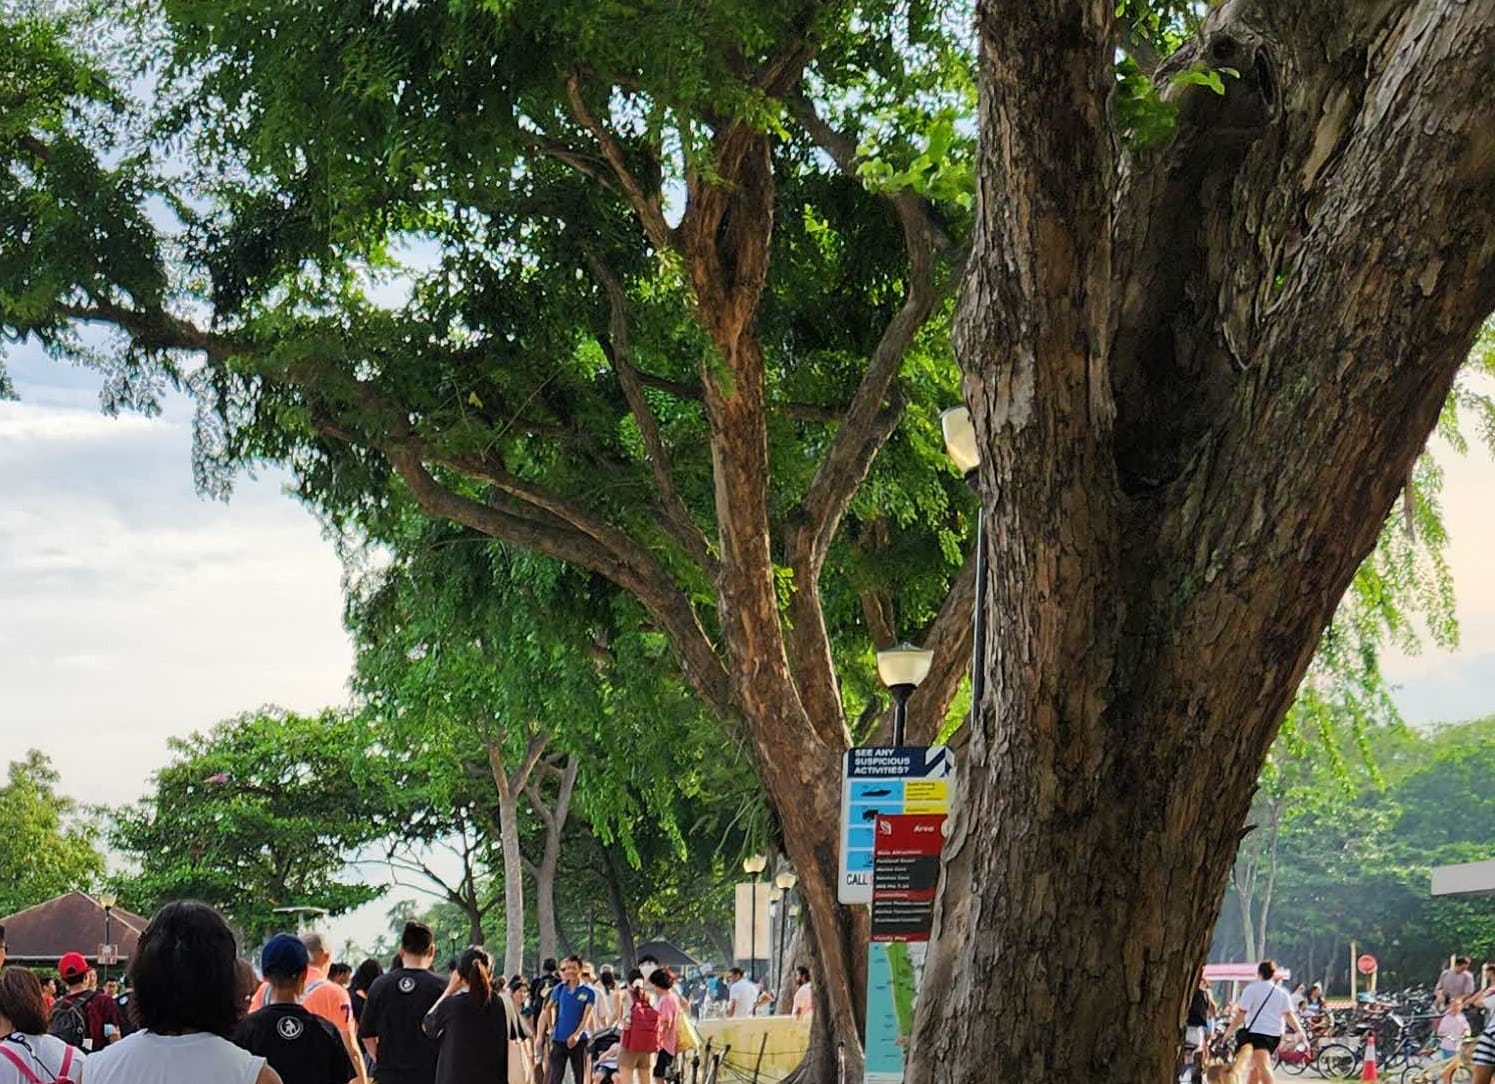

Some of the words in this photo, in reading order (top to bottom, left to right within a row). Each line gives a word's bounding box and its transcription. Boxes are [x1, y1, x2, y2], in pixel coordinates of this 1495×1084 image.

[855, 748, 873, 757] SEE
[875, 748, 895, 757] ANY
[855, 757, 910, 765] SUSPICIOUS
[854, 766, 909, 774] ACTIVITIES?
[847, 873, 867, 885] CALL
